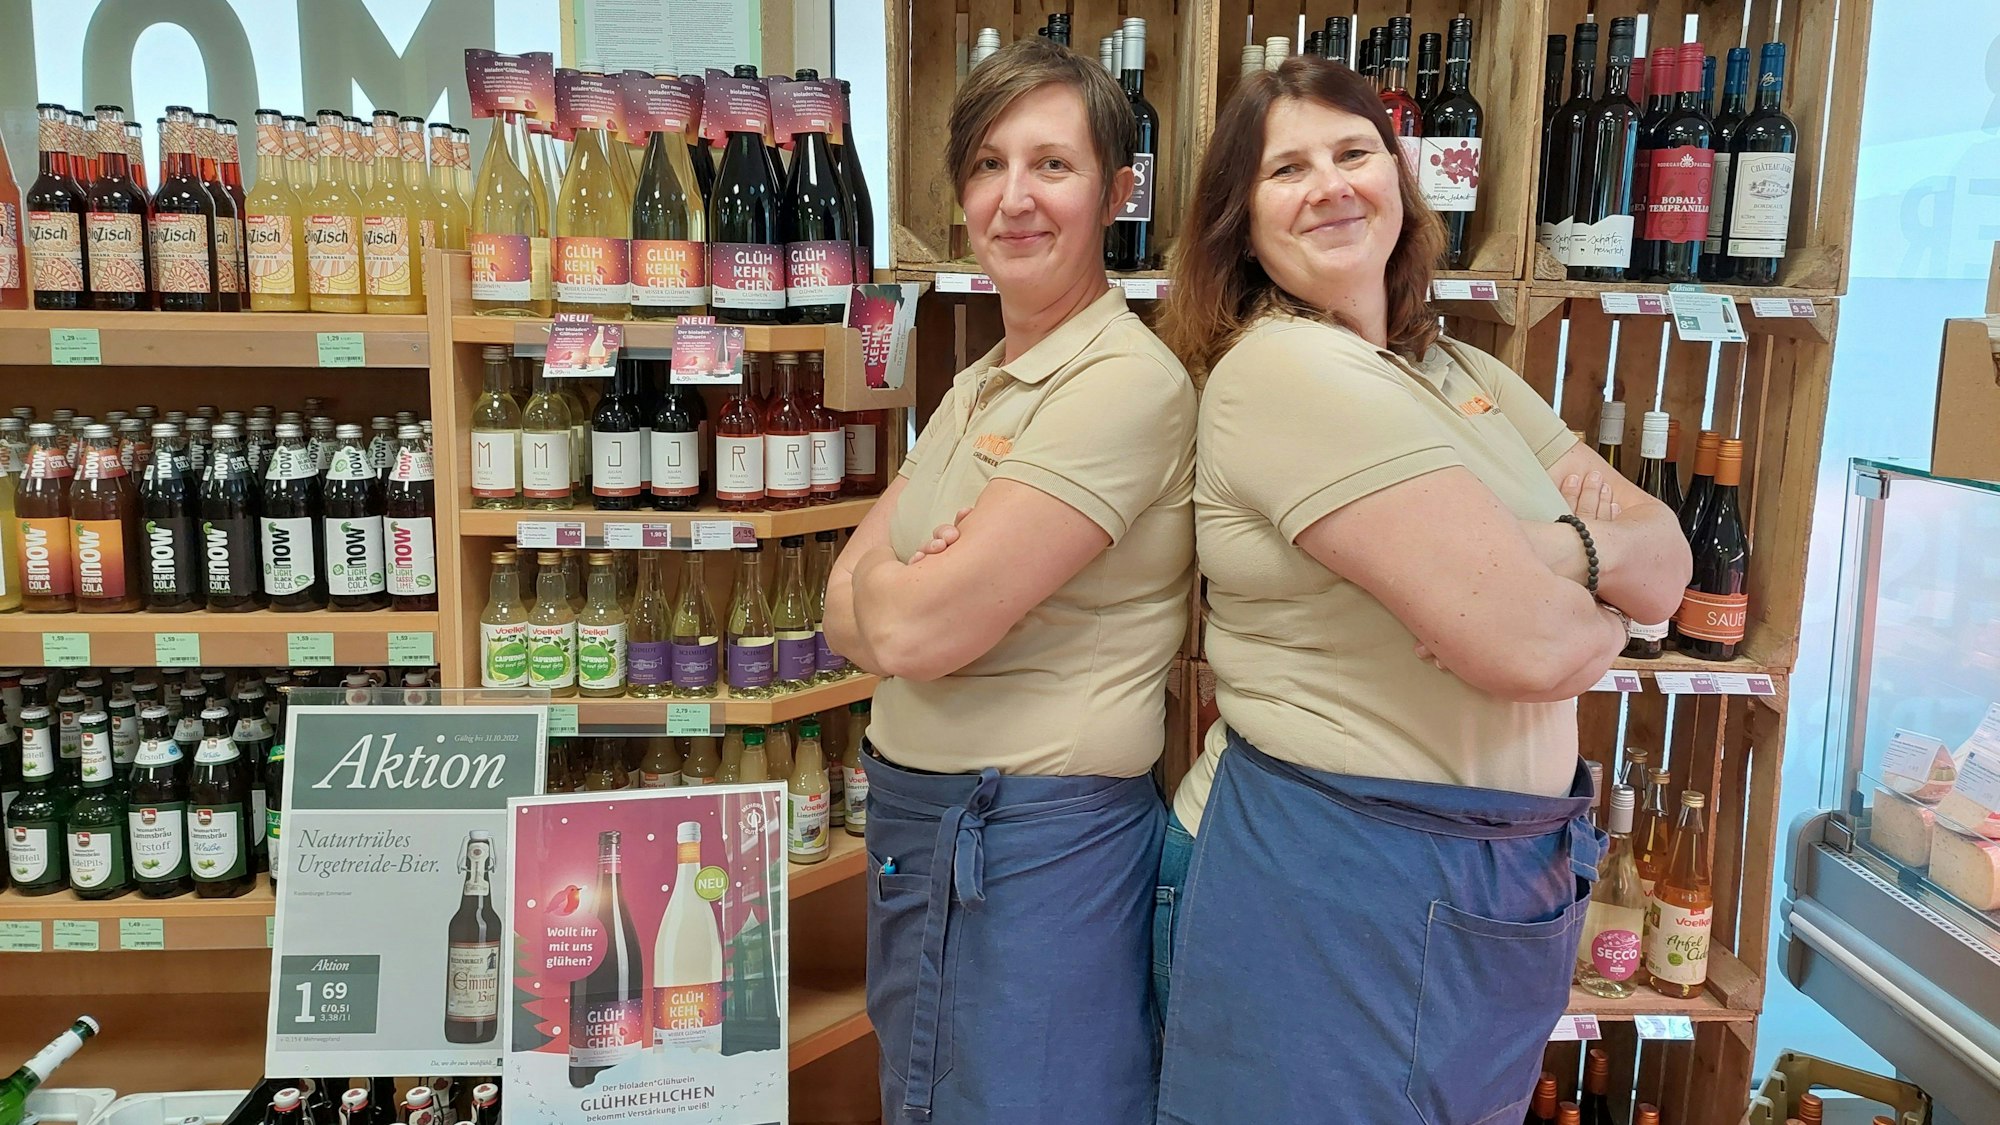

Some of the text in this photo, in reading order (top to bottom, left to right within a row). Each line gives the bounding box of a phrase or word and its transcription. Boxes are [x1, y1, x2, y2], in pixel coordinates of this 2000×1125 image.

[560, 313, 589, 322] NEU!
[682, 317, 710, 325] NEU!
[478, 441, 491, 468] M
[534, 442, 548, 468] M
[608, 441, 621, 467] J
[667, 441, 680, 467] J
[732, 446, 746, 471] R
[787, 444, 799, 469] R
[814, 440, 826, 464] R
[279, 452, 292, 477] now
[350, 452, 364, 477] now
[398, 453, 412, 479] now
[25, 527, 49, 574] now
[79, 530, 102, 576] now
[150, 528, 175, 574] now
[207, 530, 230, 575] now
[272, 528, 291, 569] now
[346, 528, 367, 568] now
[394, 527, 413, 569] now
[29, 581, 51, 590] COLA
[82, 583, 103, 593] COLA
[153, 581, 176, 589] COLA
[209, 582, 231, 591] COLA
[348, 581, 368, 589] COLA
[496, 626, 525, 634] Voelkel
[533, 628, 563, 636] Voelkel
[454, 734, 519, 743] Gültig bis 31.10.2022
[311, 732, 507, 790] Aktion
[133, 831, 172, 839] Lammsbräu
[297, 829, 411, 849] Naturtrübes
[135, 841, 171, 851] Urstoff
[72, 859, 103, 867] EdelPils
[298, 853, 440, 878] Urgetreide-Bier.
[698, 878, 724, 889] NEU
[547, 927, 597, 937] Wollt ihr
[549, 942, 593, 952] mit uns
[1667, 934, 1703, 951] Apfel
[546, 956, 592, 968] glühen?
[1597, 947, 1637, 960] SECCO
[311, 958, 350, 971] Aktion
[295, 982, 348, 1022] 1 69
[602, 1084, 618, 1092] Der
[580, 1086, 715, 1112] GLÜHKEHLCHEN
[586, 1102, 710, 1123] bekommt Verstärkung in weiß!
